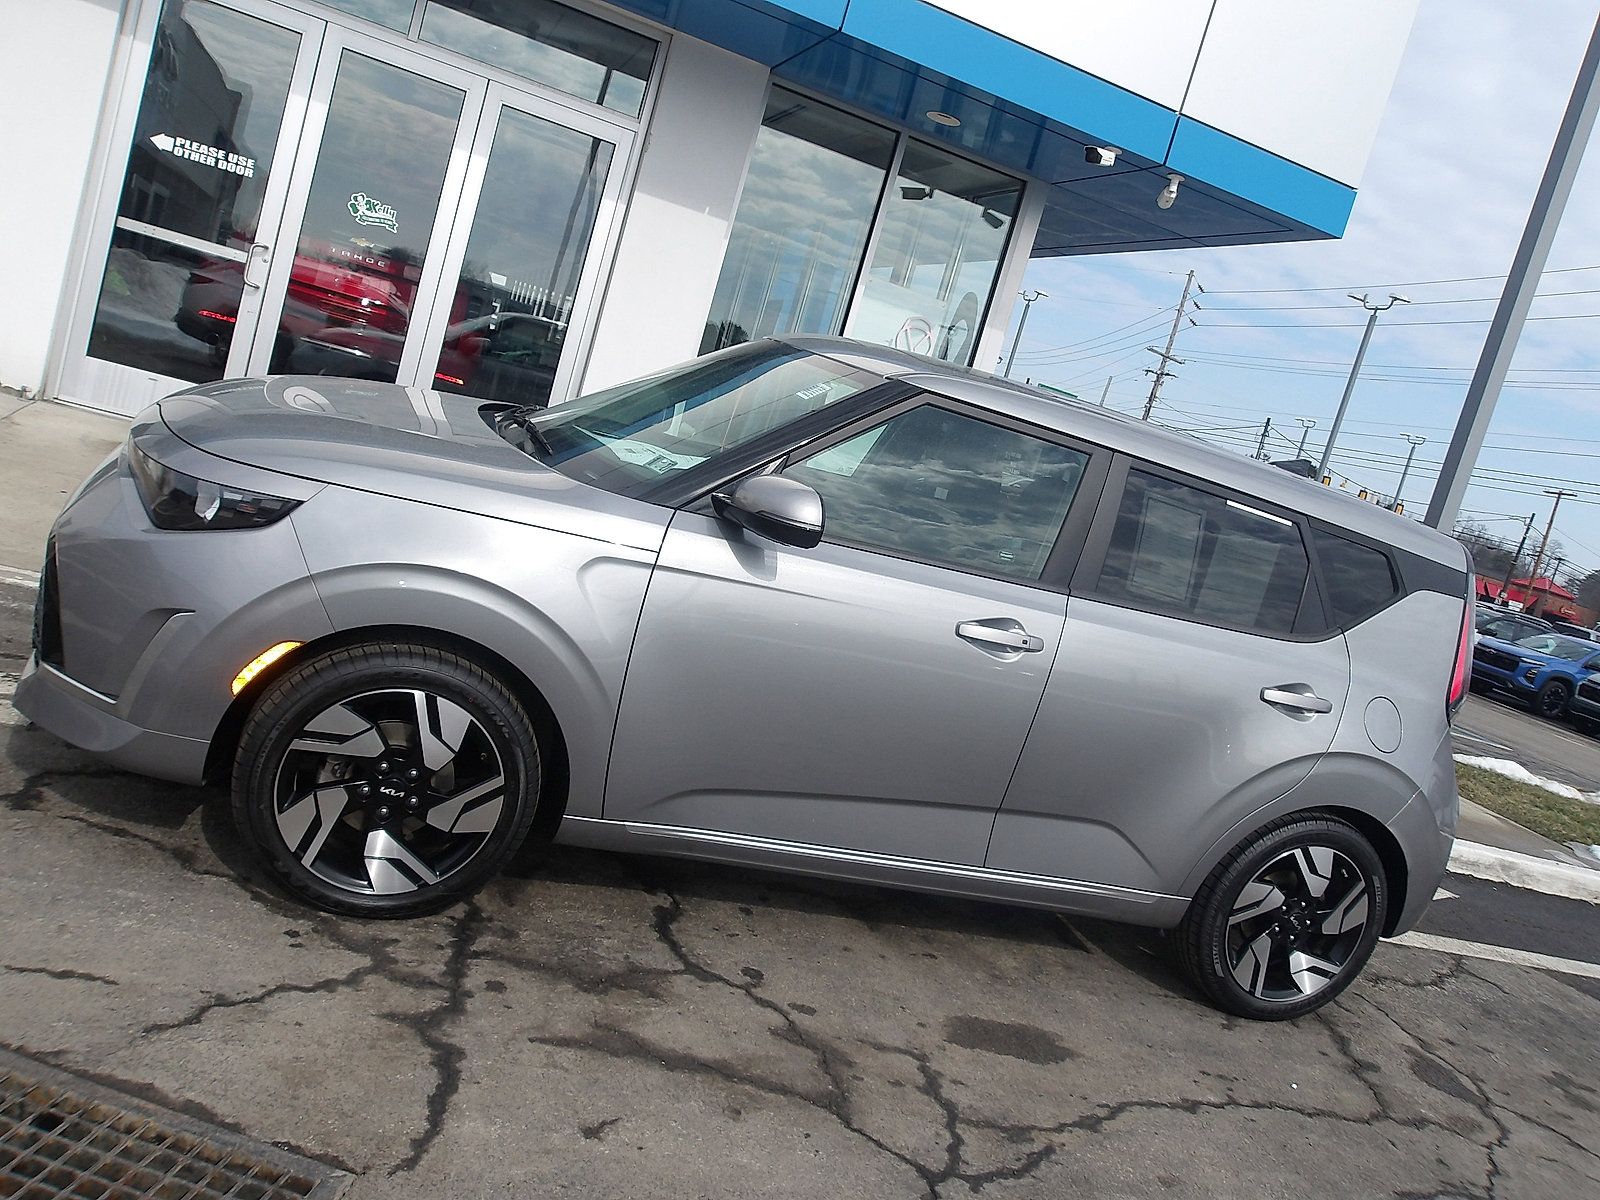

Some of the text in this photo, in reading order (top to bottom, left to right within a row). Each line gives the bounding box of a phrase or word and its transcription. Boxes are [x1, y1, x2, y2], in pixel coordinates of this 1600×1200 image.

[173, 146, 254, 178] OTHER DOOR
[175, 137, 256, 169] PLEASE USE
[371, 201, 396, 219] Kelly
[330, 247, 386, 267] TAHOE
